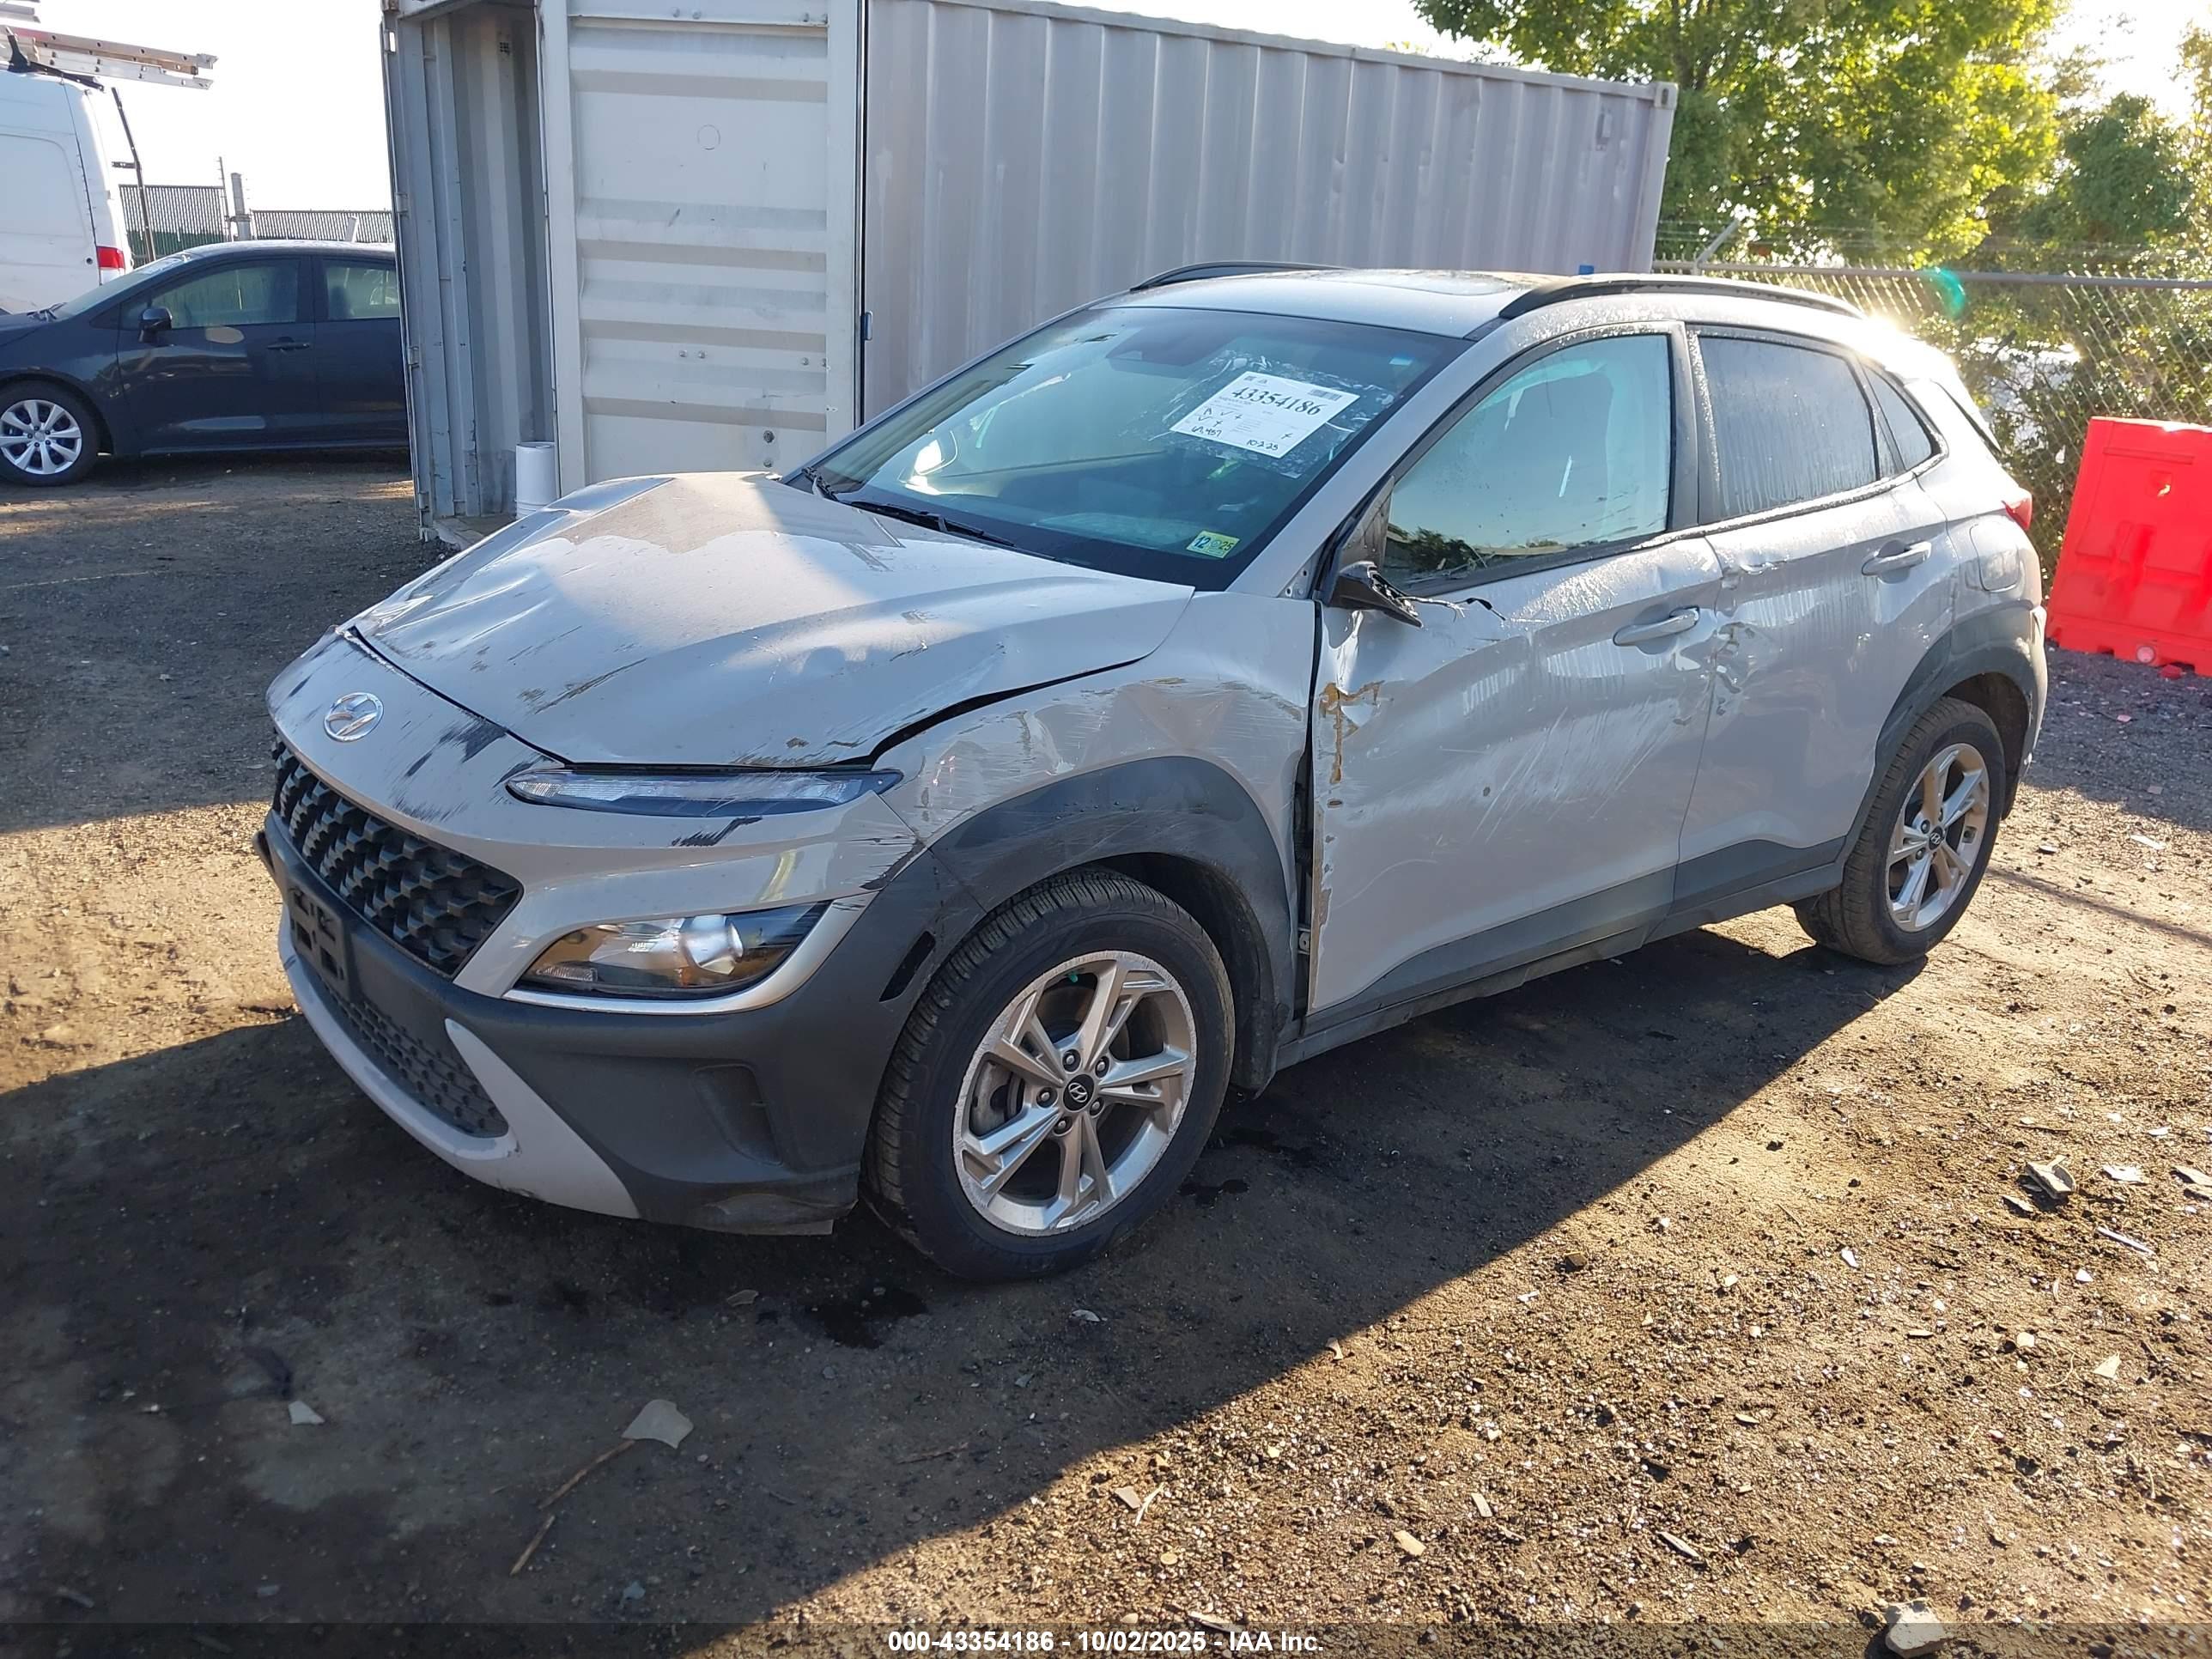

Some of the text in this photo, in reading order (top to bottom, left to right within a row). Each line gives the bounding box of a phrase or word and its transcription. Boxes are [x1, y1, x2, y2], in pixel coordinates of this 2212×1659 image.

[1232, 386, 1327, 416] 43354186
[1194, 536, 1234, 550] 12 25
